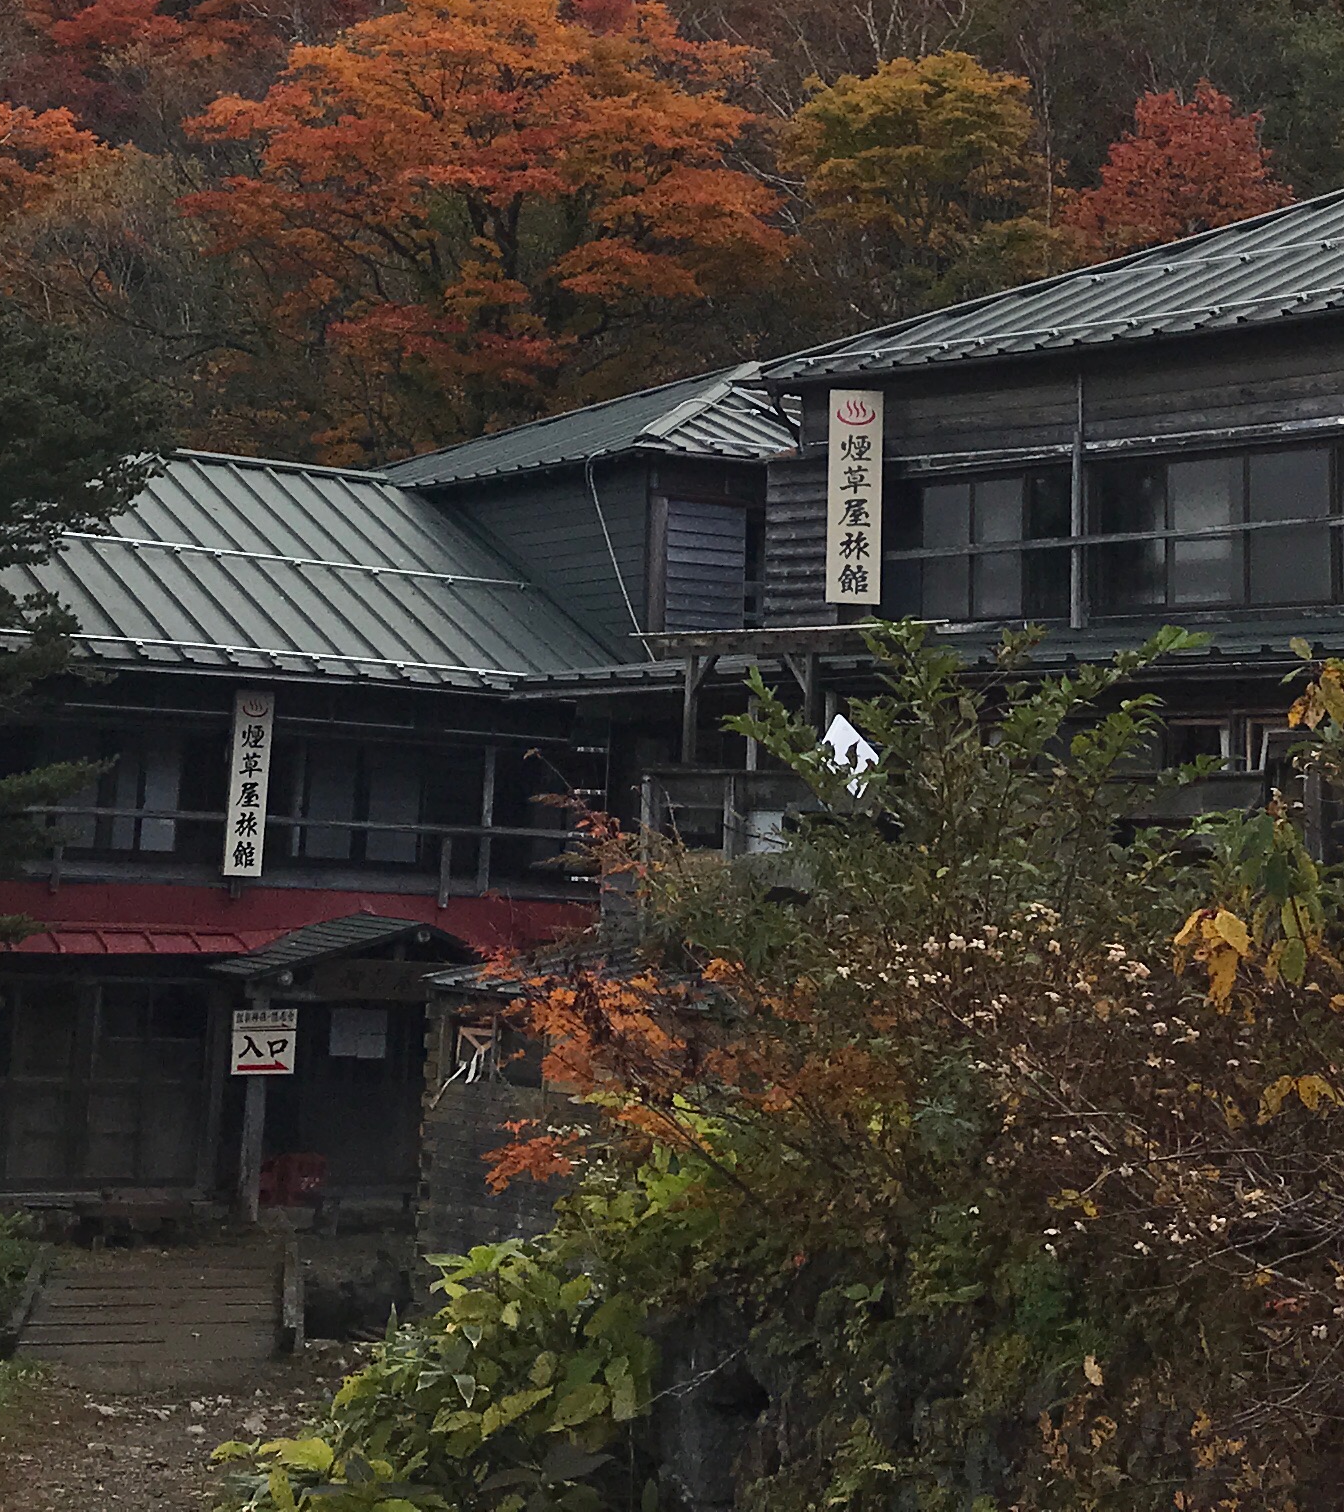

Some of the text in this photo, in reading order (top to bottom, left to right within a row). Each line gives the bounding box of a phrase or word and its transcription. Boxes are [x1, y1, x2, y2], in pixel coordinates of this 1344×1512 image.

[837, 434, 872, 586] 煙草屋旅館
[233, 724, 265, 869] 煙草屋旅館
[238, 1035, 289, 1059] 入口
